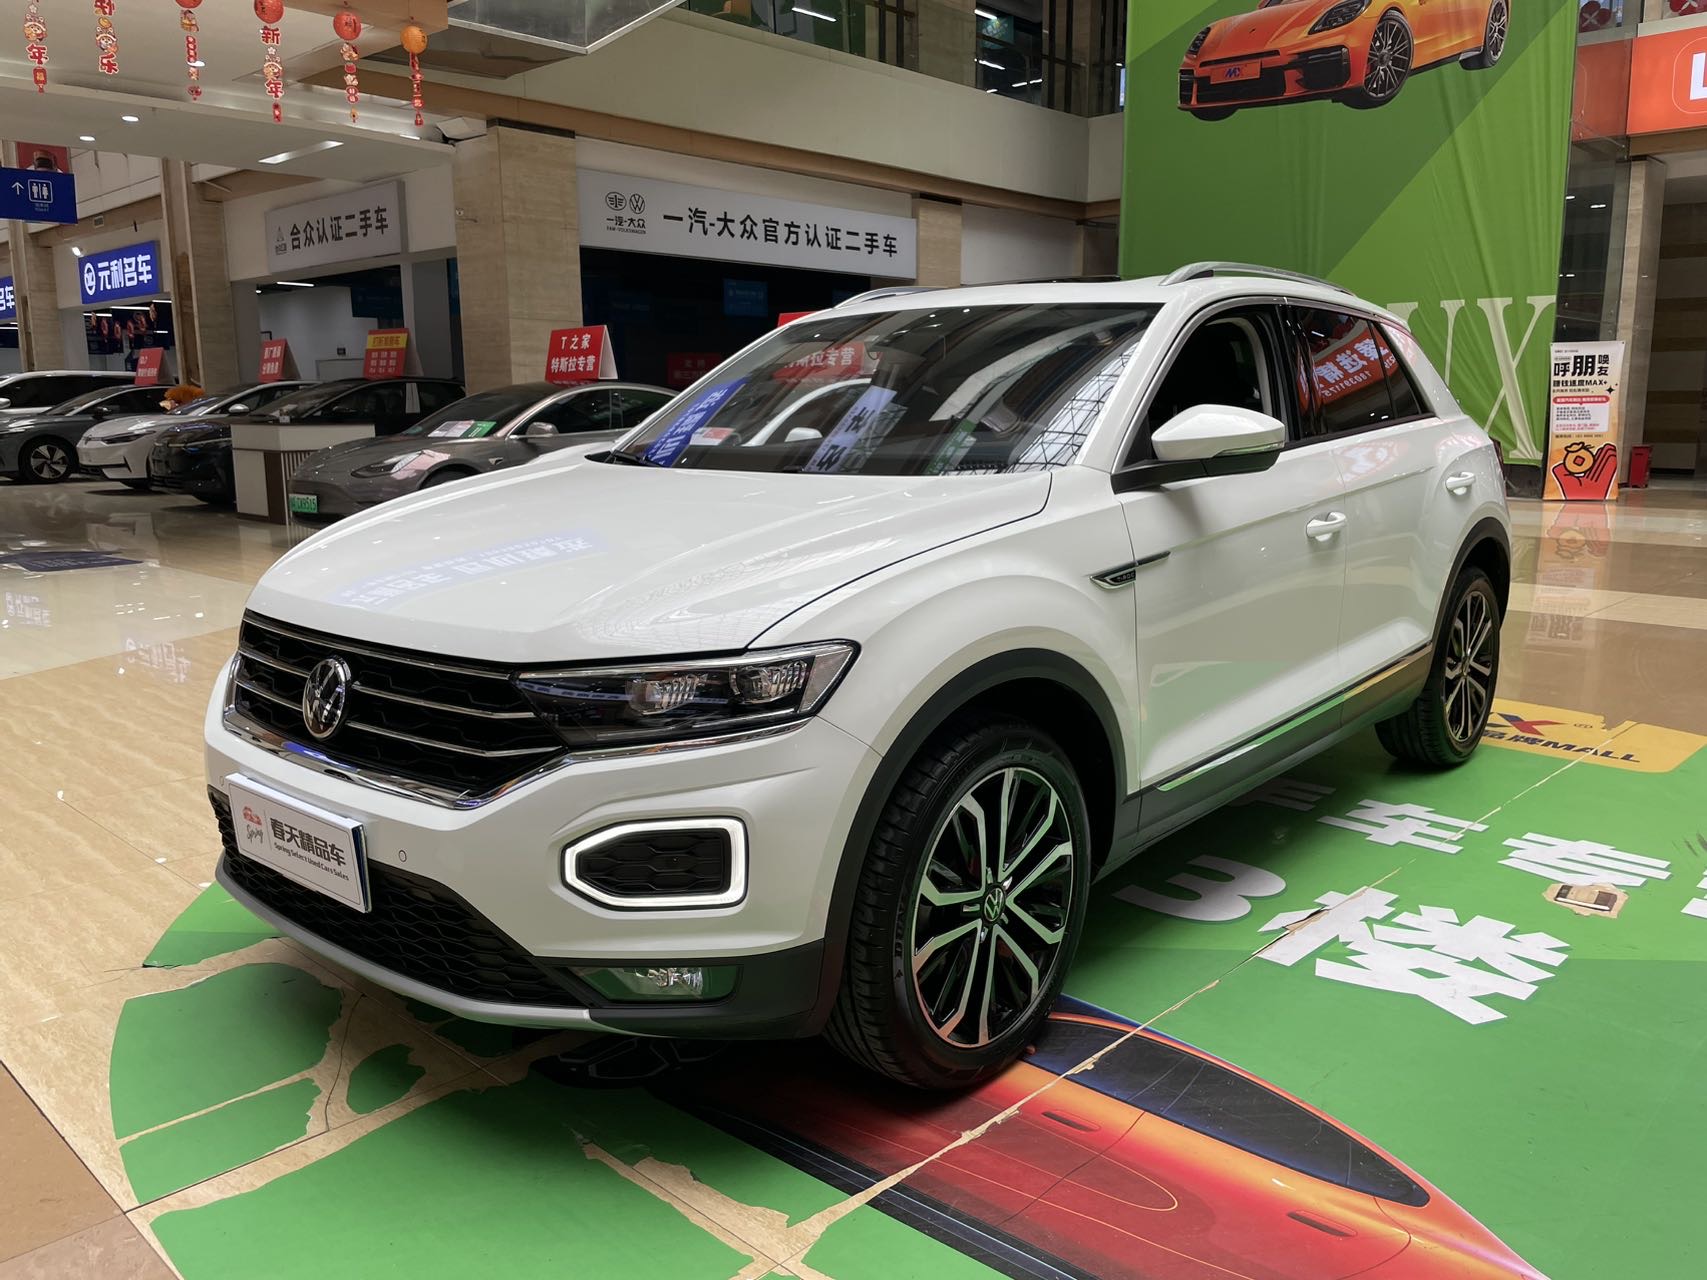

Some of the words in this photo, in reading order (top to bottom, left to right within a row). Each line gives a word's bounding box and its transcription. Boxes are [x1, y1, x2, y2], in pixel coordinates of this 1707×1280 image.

[261, 26, 281, 45] 新
[27, 44, 49, 65] 年
[266, 80, 284, 99] 年
[290, 206, 389, 251] 合众认证二手车
[663, 207, 898, 258] 一汽-大众官方认证二手车
[98, 254, 153, 291] 元利名车
[551, 355, 596, 374] 特斯拉专营
[785, 347, 856, 369] 斯拉专营
[269, 817, 347, 867] 春天精品车
[308, 857, 321, 869] Used
